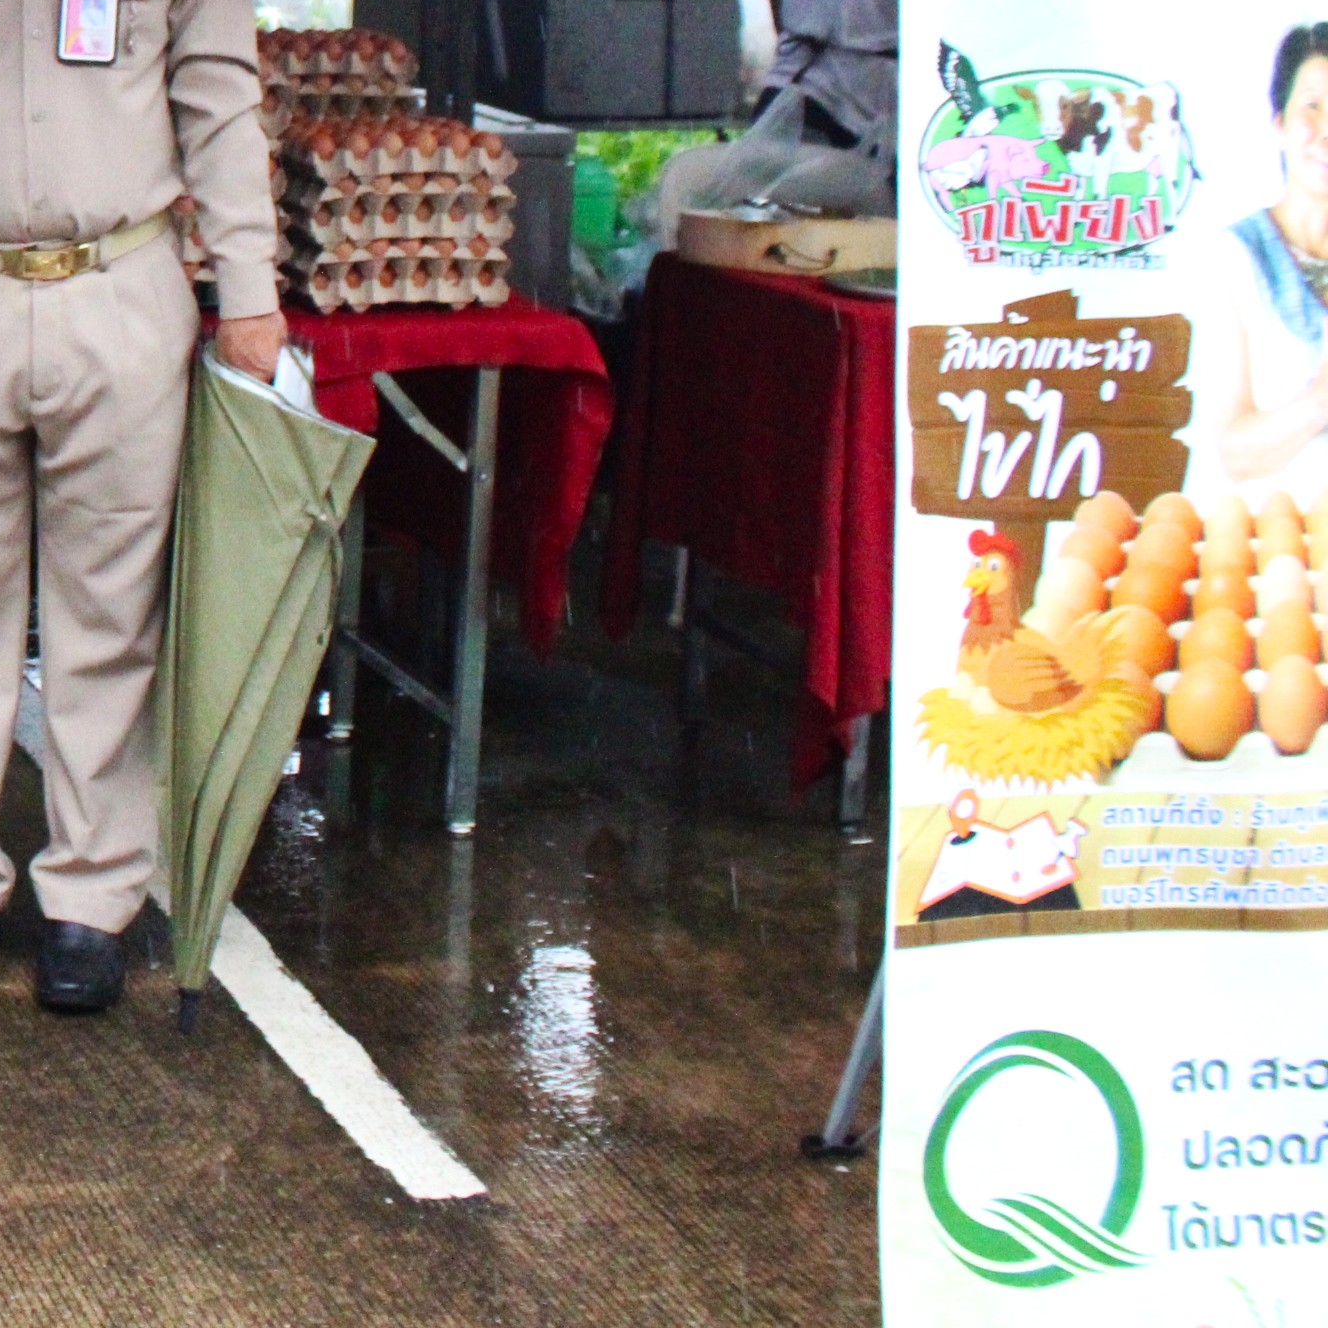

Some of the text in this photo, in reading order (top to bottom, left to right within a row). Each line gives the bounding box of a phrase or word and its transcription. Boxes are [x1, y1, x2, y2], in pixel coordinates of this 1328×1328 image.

[954, 173, 1166, 268] ภูเพียง
[938, 312, 1152, 374] สินค้าแนะนำ
[937, 378, 1118, 500] ไข่ไก่
[1171, 1058, 1229, 1093] สด
[923, 1030, 1158, 1289] Q
